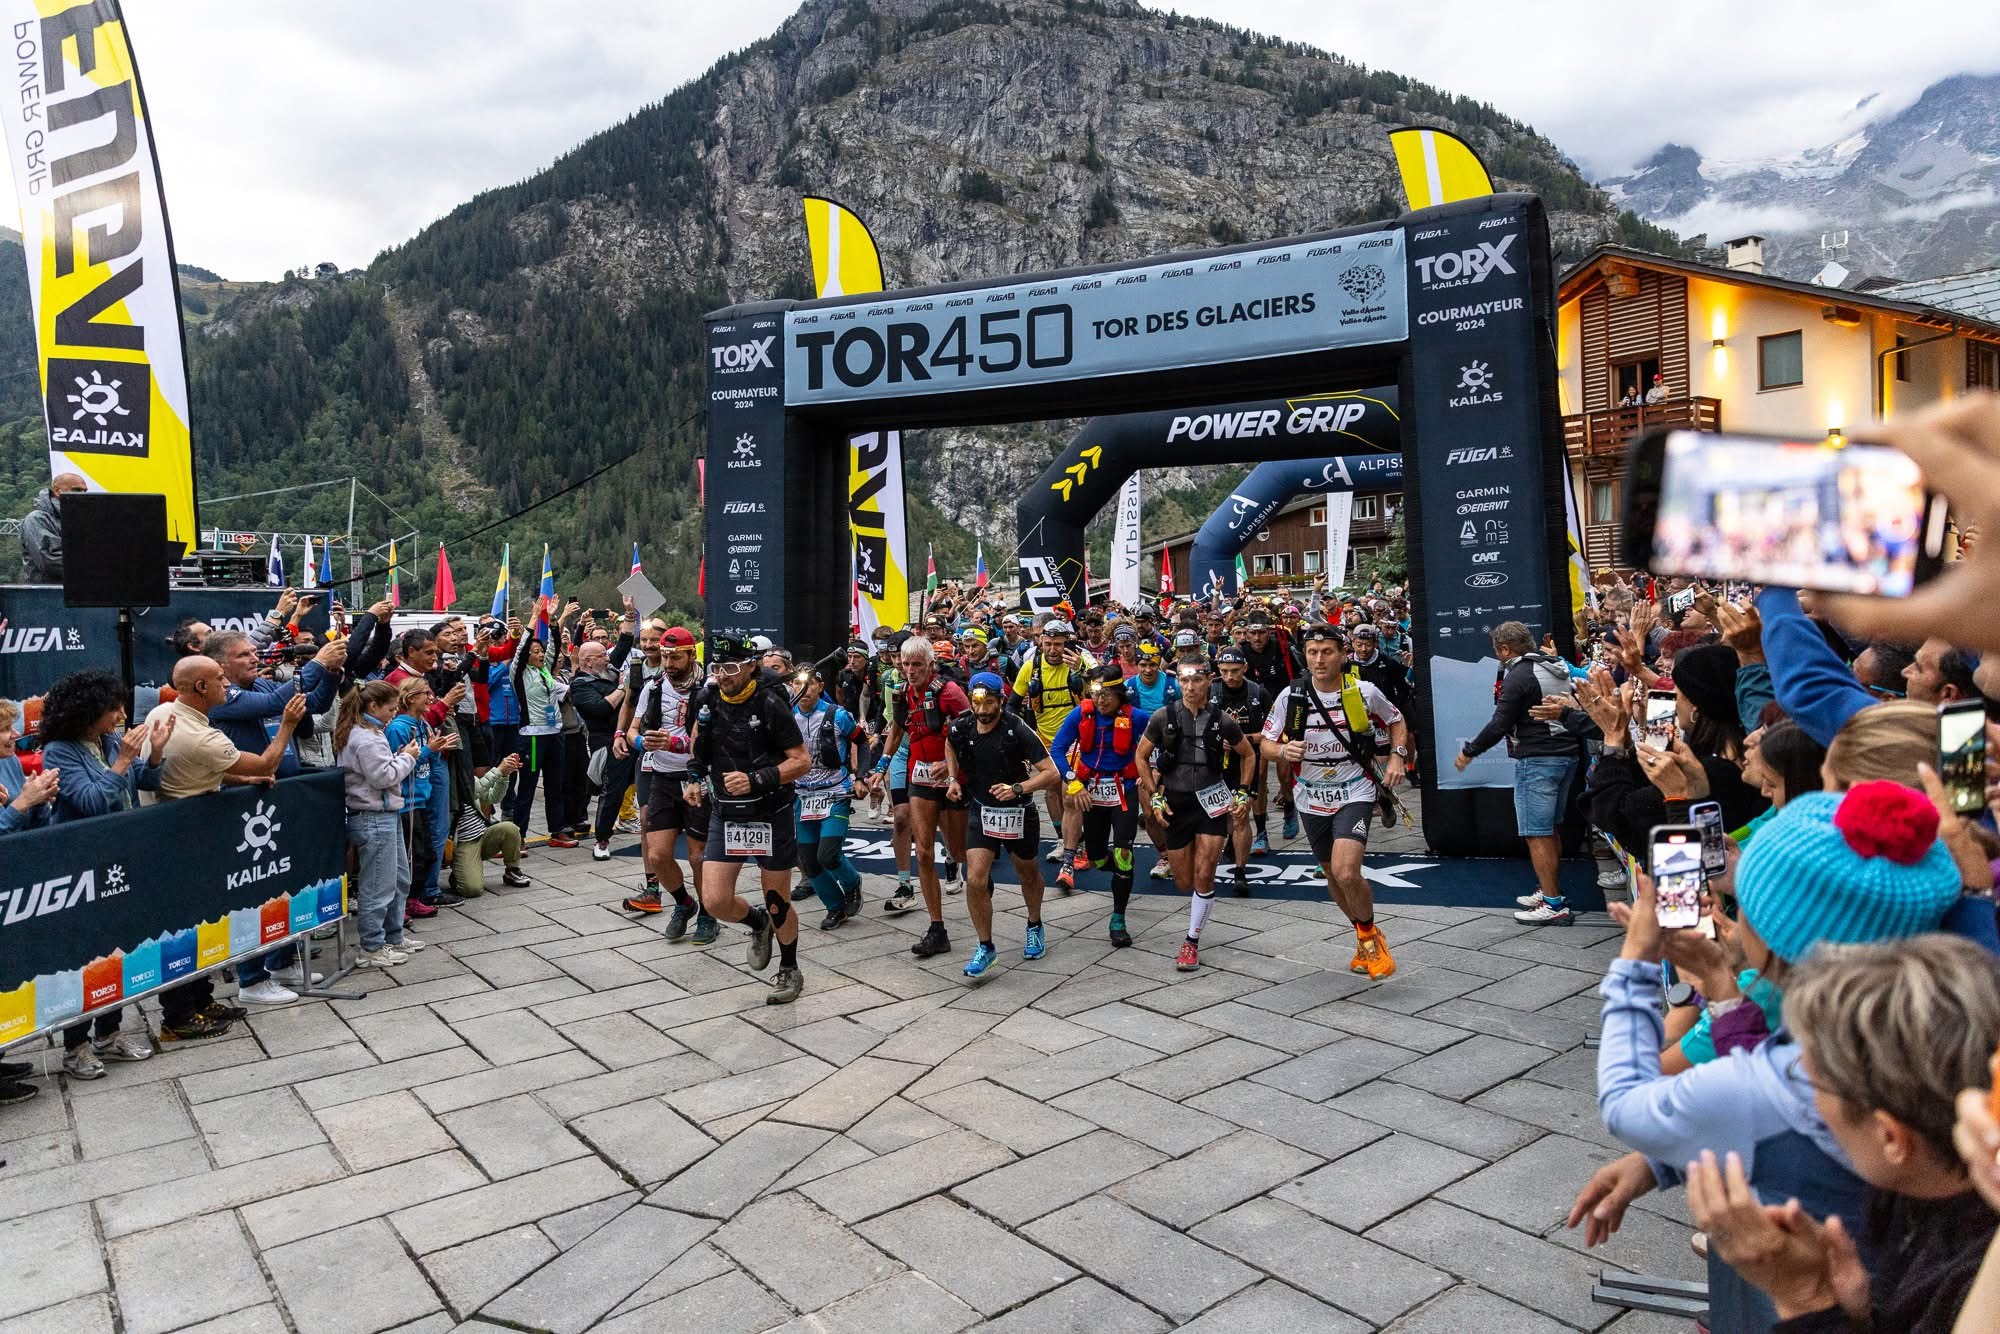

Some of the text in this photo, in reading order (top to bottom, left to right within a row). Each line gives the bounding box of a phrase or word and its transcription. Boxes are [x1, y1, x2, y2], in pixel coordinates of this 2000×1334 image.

[1479, 217, 1507, 230] FUGA
[1414, 229, 1441, 242] FUGA
[1415, 233, 1518, 284] TORX
[1431, 278, 1469, 291] KAILAS
[1092, 292, 1316, 340] TOR DES GLACIERS
[1417, 297, 1524, 325] COURMAYEUR
[1455, 318, 1486, 332] 2024
[711, 335, 776, 372] TORX
[796, 303, 1073, 390] TOR450
[711, 386, 778, 401] COURMAYEUR
[1450, 391, 1503, 408] KAILAS
[734, 401, 754, 409] 2024
[1166, 403, 1366, 443] POWER GRIP
[1446, 447, 1498, 465] FUGA
[727, 459, 762, 469] KAILAS
[1456, 485, 1510, 499] GARMIN
[723, 502, 756, 514] FUGA
[1471, 500, 1510, 513] ENERVIT
[1239, 500, 1279, 541] ALPISSIMA
[727, 533, 762, 541] GARMIN
[1472, 551, 1500, 563] CAAT
[1044, 556, 1067, 592] POWER
[1473, 574, 1500, 586] Ford
[0, 627, 63, 654] UGA
[1094, 785, 1117, 796] 4135
[1313, 789, 1342, 803] 4154
[806, 799, 827, 810] 4120
[989, 815, 1016, 828] 4117
[734, 830, 763, 844] 4129
[226, 856, 291, 891] KAILAS
[100, 884, 131, 899] KAILAS
[91, 983, 117, 999] TOR30
